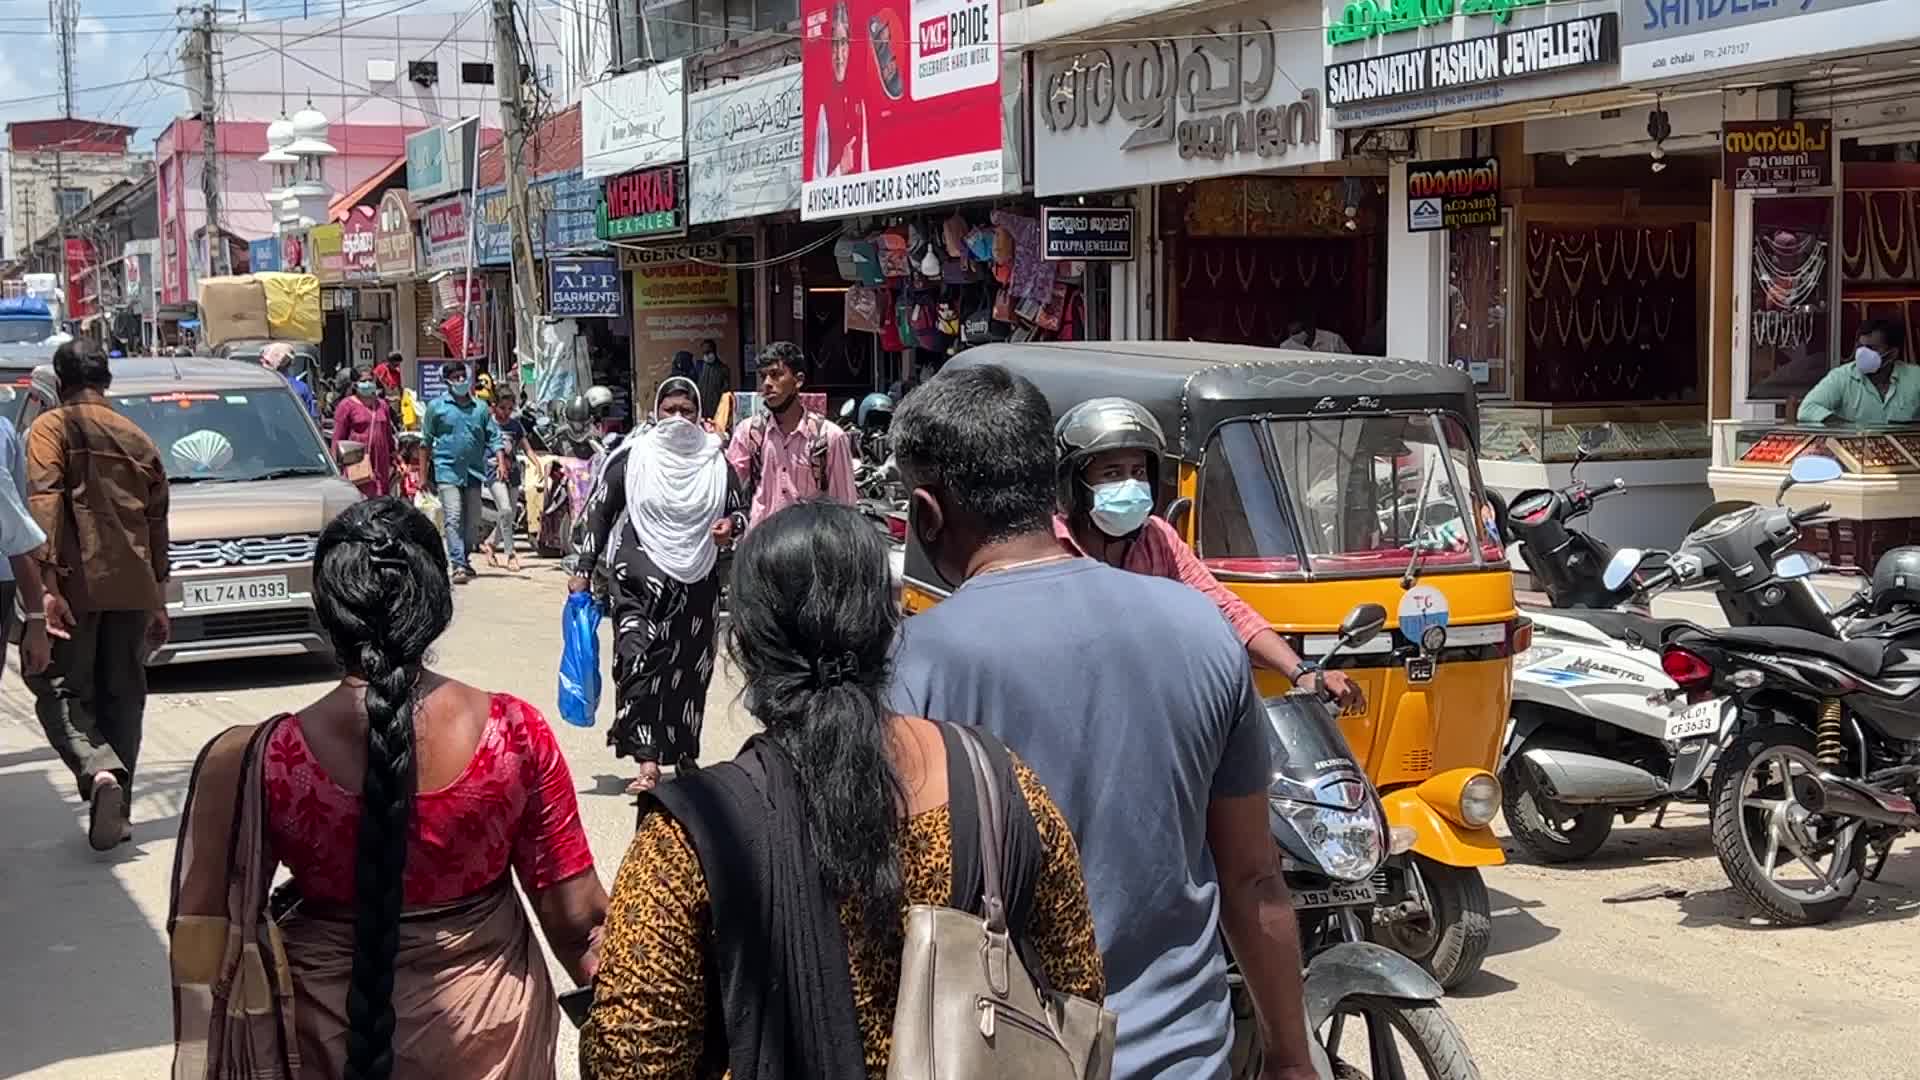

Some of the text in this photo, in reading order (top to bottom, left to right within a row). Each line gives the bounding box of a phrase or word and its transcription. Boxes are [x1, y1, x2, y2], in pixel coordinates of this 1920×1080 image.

[951, 4, 989, 49] PRIDE
[1644, 0, 1777, 30] SAND
[921, 20, 947, 53] VKC
[919, 57, 950, 79] CELEBRATE
[951, 53, 968, 71] HARD
[1328, 17, 1603, 104] SARASWATHY FASHION JEWELLERY
[1670, 51, 1695, 65] chalai
[607, 168, 674, 219] MEHRAJ
[808, 183, 840, 212] AYISHA
[842, 177, 895, 207] FOOTWEAR
[896, 176, 903, 200] &
[906, 170, 941, 201] SHOES
[609, 212, 674, 234] TEXTILES
[626, 243, 718, 265] AGENCIES
[553, 291, 621, 303] GARMENTS
[1314, 757, 1353, 770] HONDA
